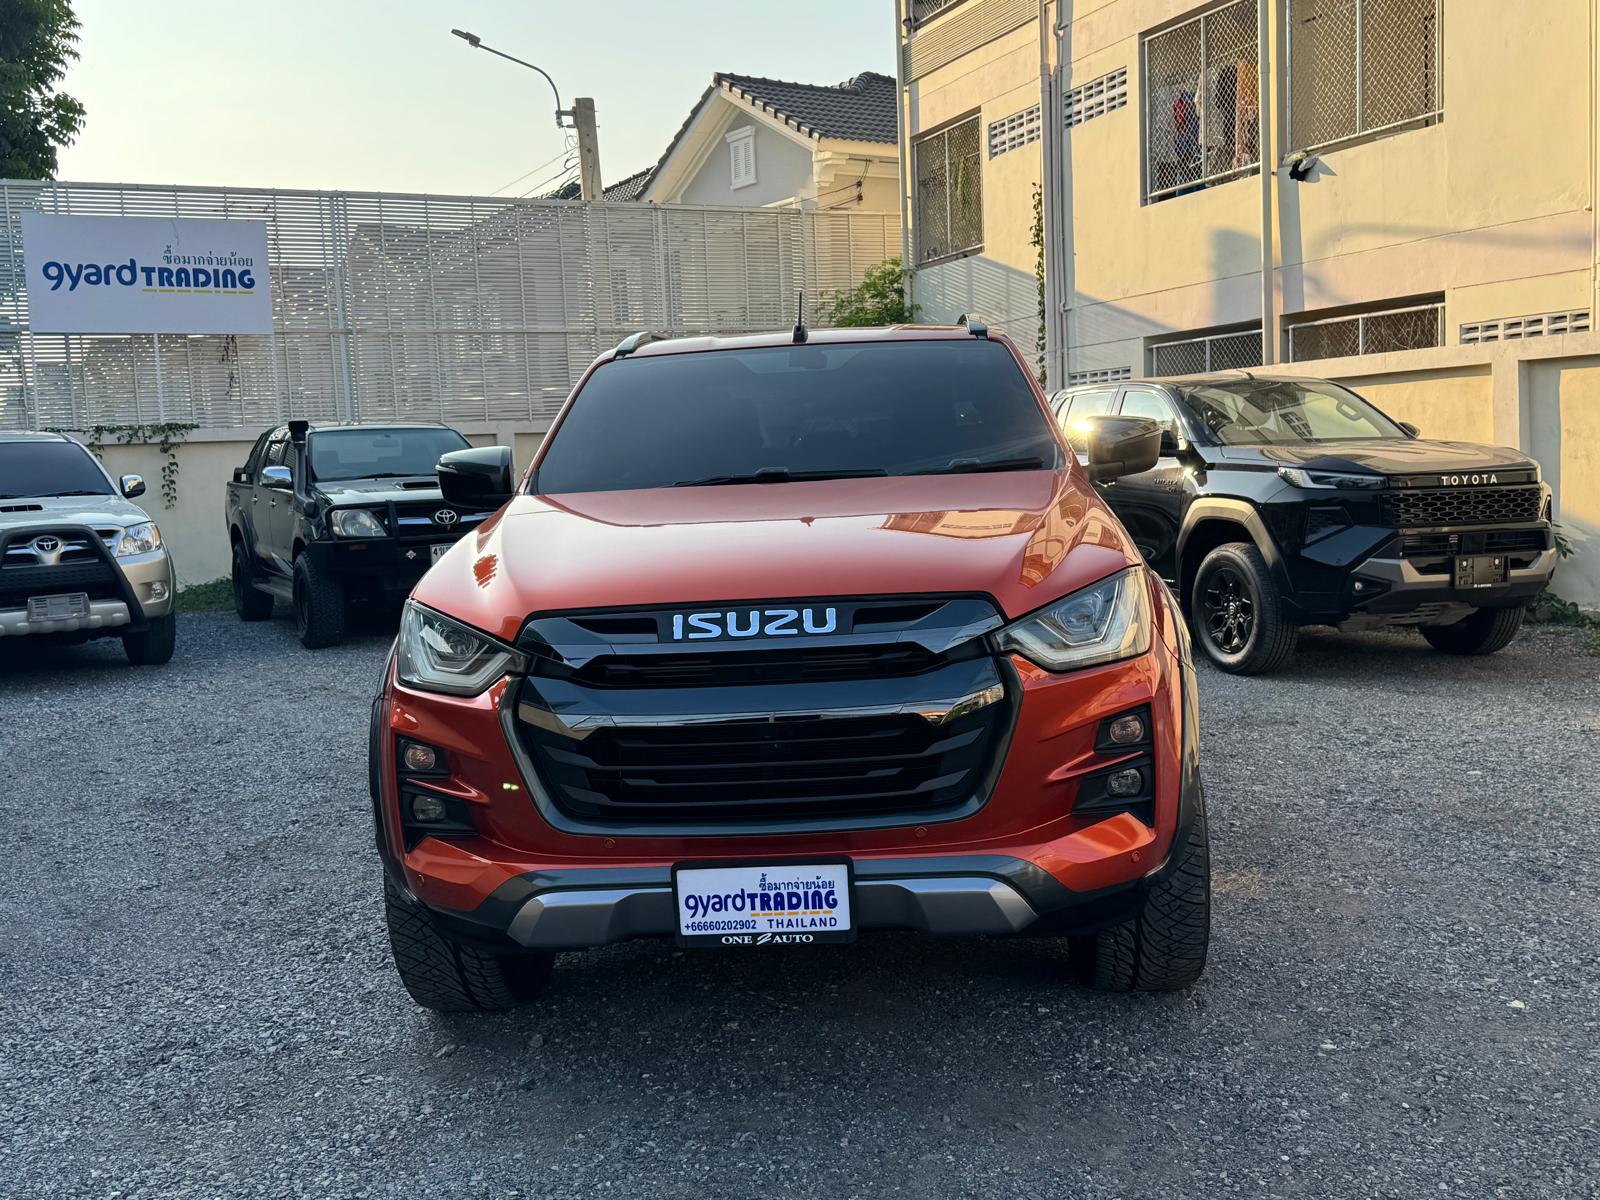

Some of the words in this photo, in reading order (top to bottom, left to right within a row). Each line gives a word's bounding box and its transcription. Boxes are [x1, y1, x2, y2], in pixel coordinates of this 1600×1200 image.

[163, 245, 254, 267] ซื้อมากจ่ายน้อย
[140, 266, 256, 289] TRADING
[1441, 474, 1498, 486] TOYOTA
[673, 607, 836, 640] ISUZU
[758, 873, 835, 891] ซื้อมากจ่ายน้อย
[684, 919, 757, 932] +66660202902
[767, 917, 838, 929] THAILAND
[721, 935, 753, 945] ONE
[772, 934, 814, 944] AUTO
